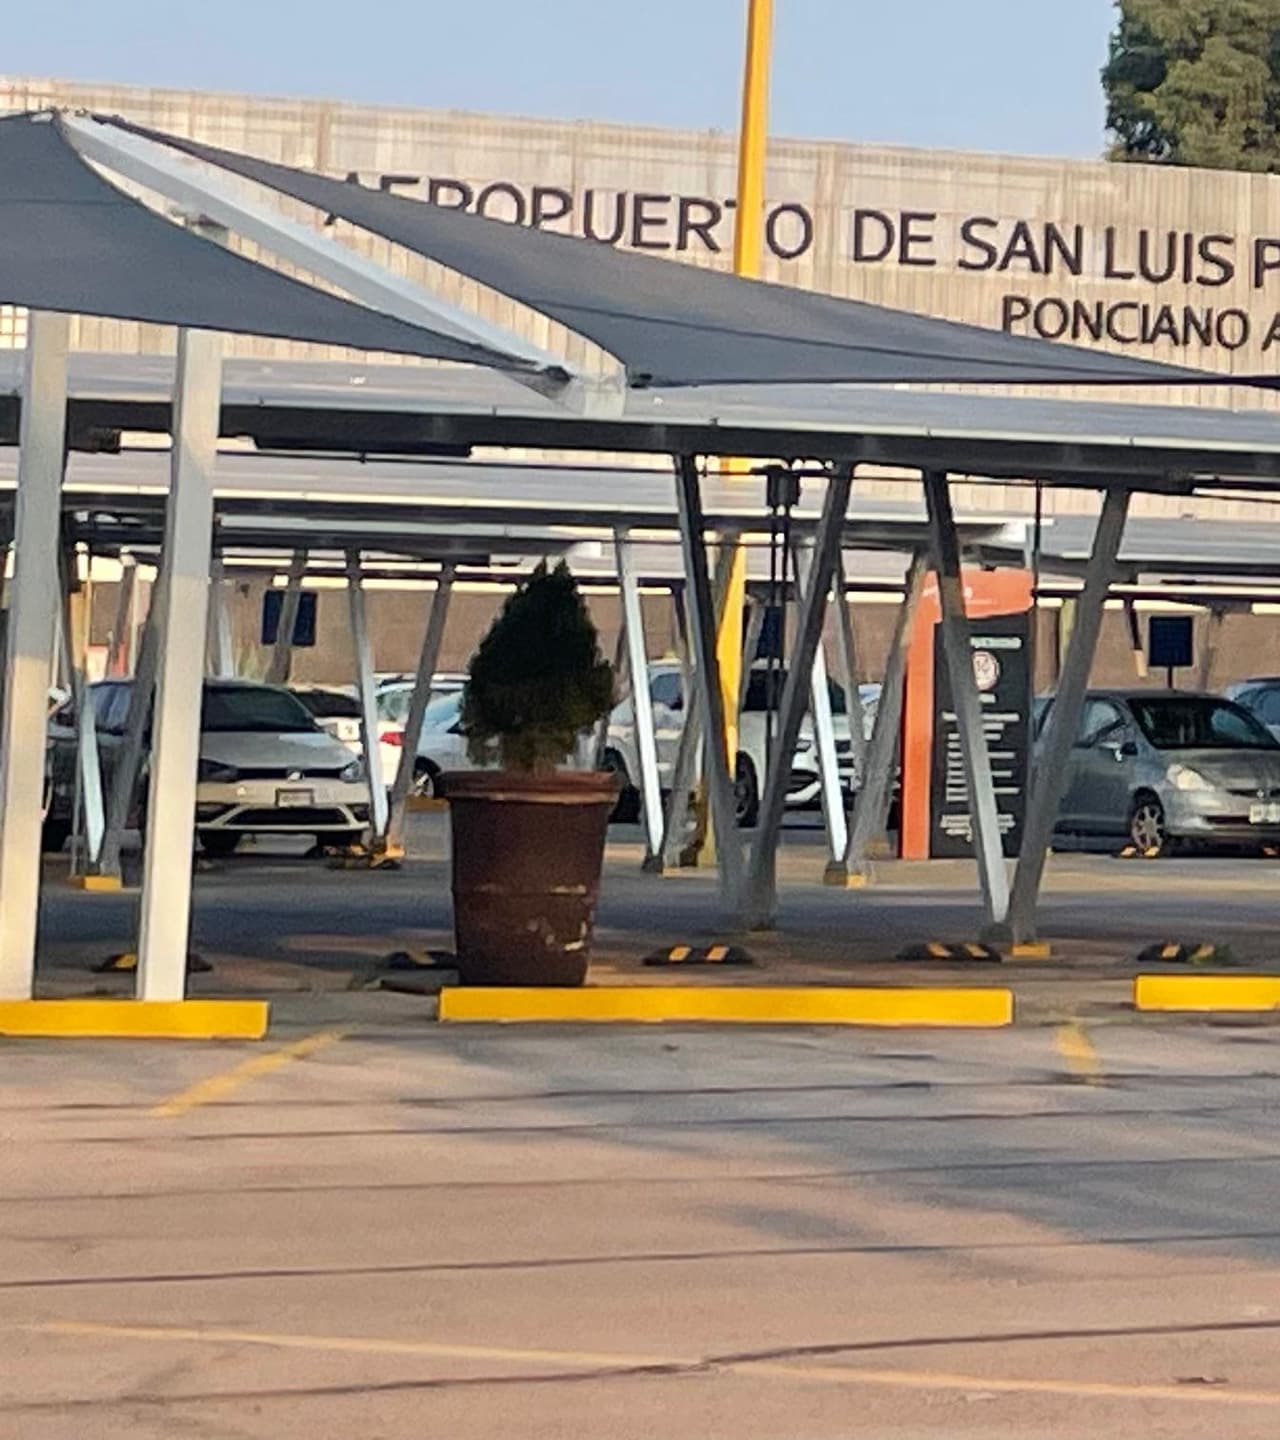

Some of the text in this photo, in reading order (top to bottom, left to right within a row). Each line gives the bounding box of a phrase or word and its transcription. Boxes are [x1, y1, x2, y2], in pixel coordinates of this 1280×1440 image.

[325, 171, 813, 259] ROPUERO
[854, 209, 937, 266] DE
[958, 216, 1083, 276] SAN
[1103, 225, 1235, 287] LUIS
[1002, 295, 1250, 351] PONCIANO
